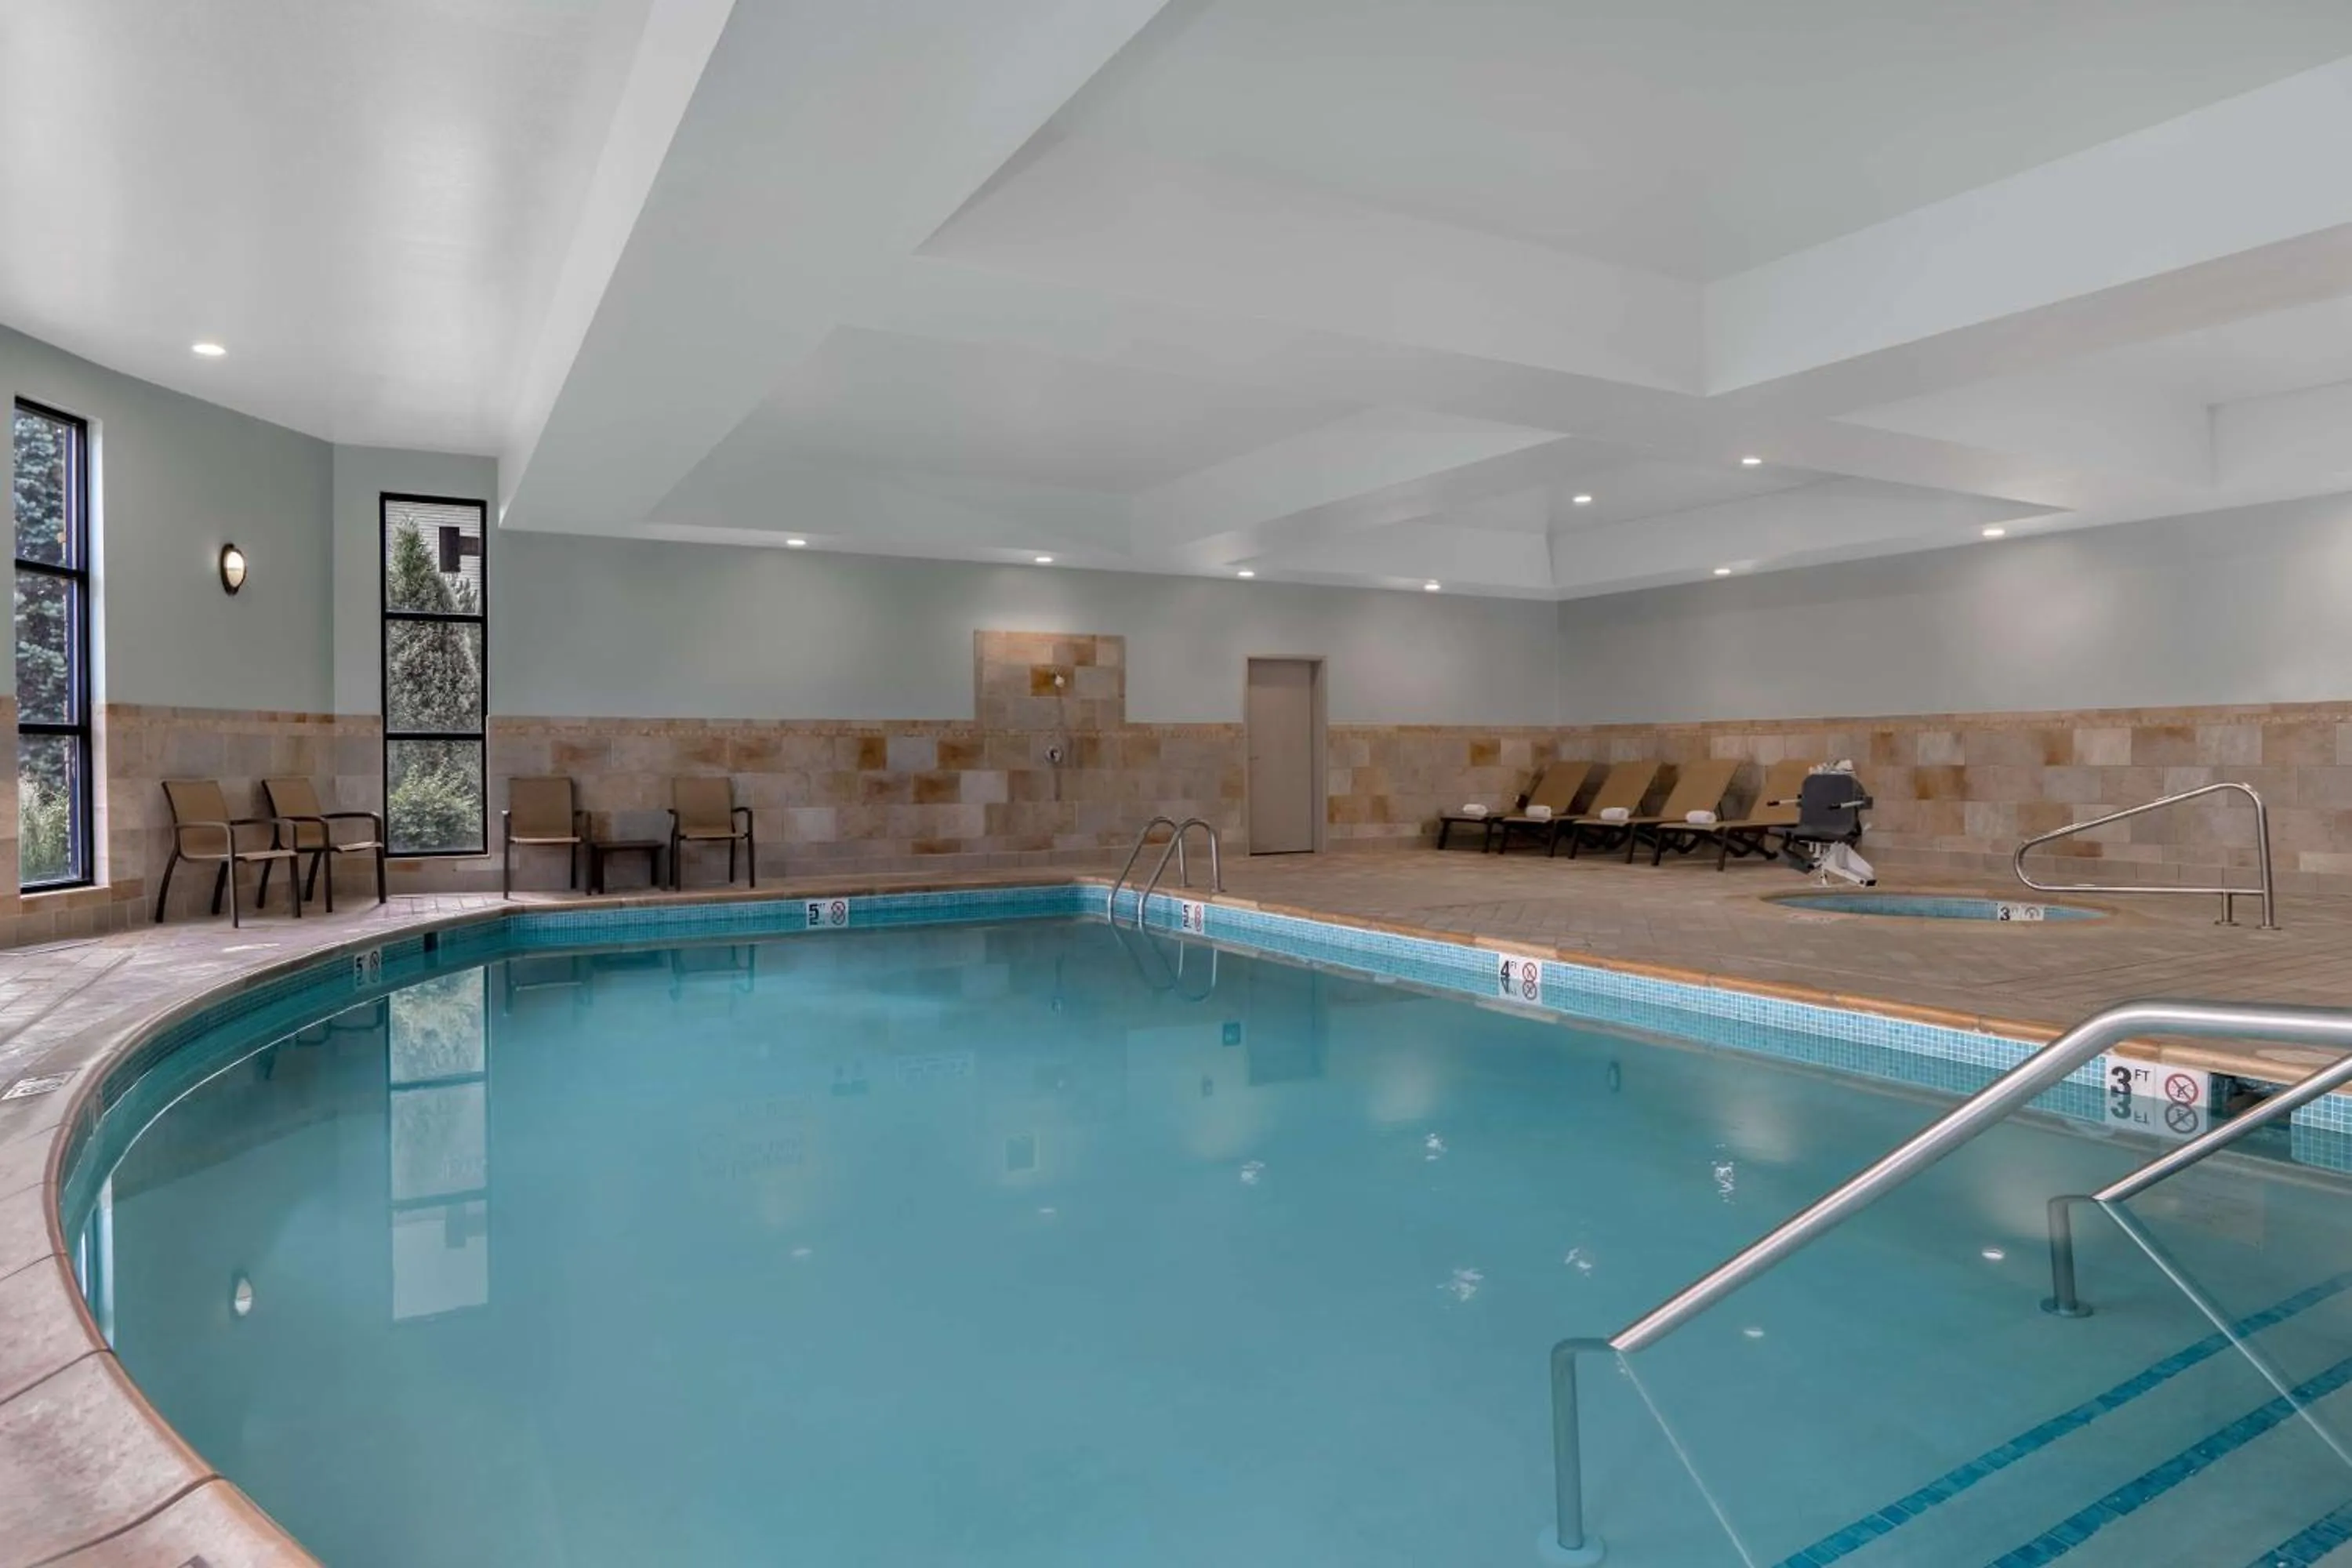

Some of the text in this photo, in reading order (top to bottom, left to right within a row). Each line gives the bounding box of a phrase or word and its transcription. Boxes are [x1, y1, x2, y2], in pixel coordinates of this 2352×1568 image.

[808, 903, 819, 916] 5
[2000, 906, 2010, 920] 3
[1501, 960, 1510, 978] 4
[2111, 1066, 2151, 1094] 3 FT
